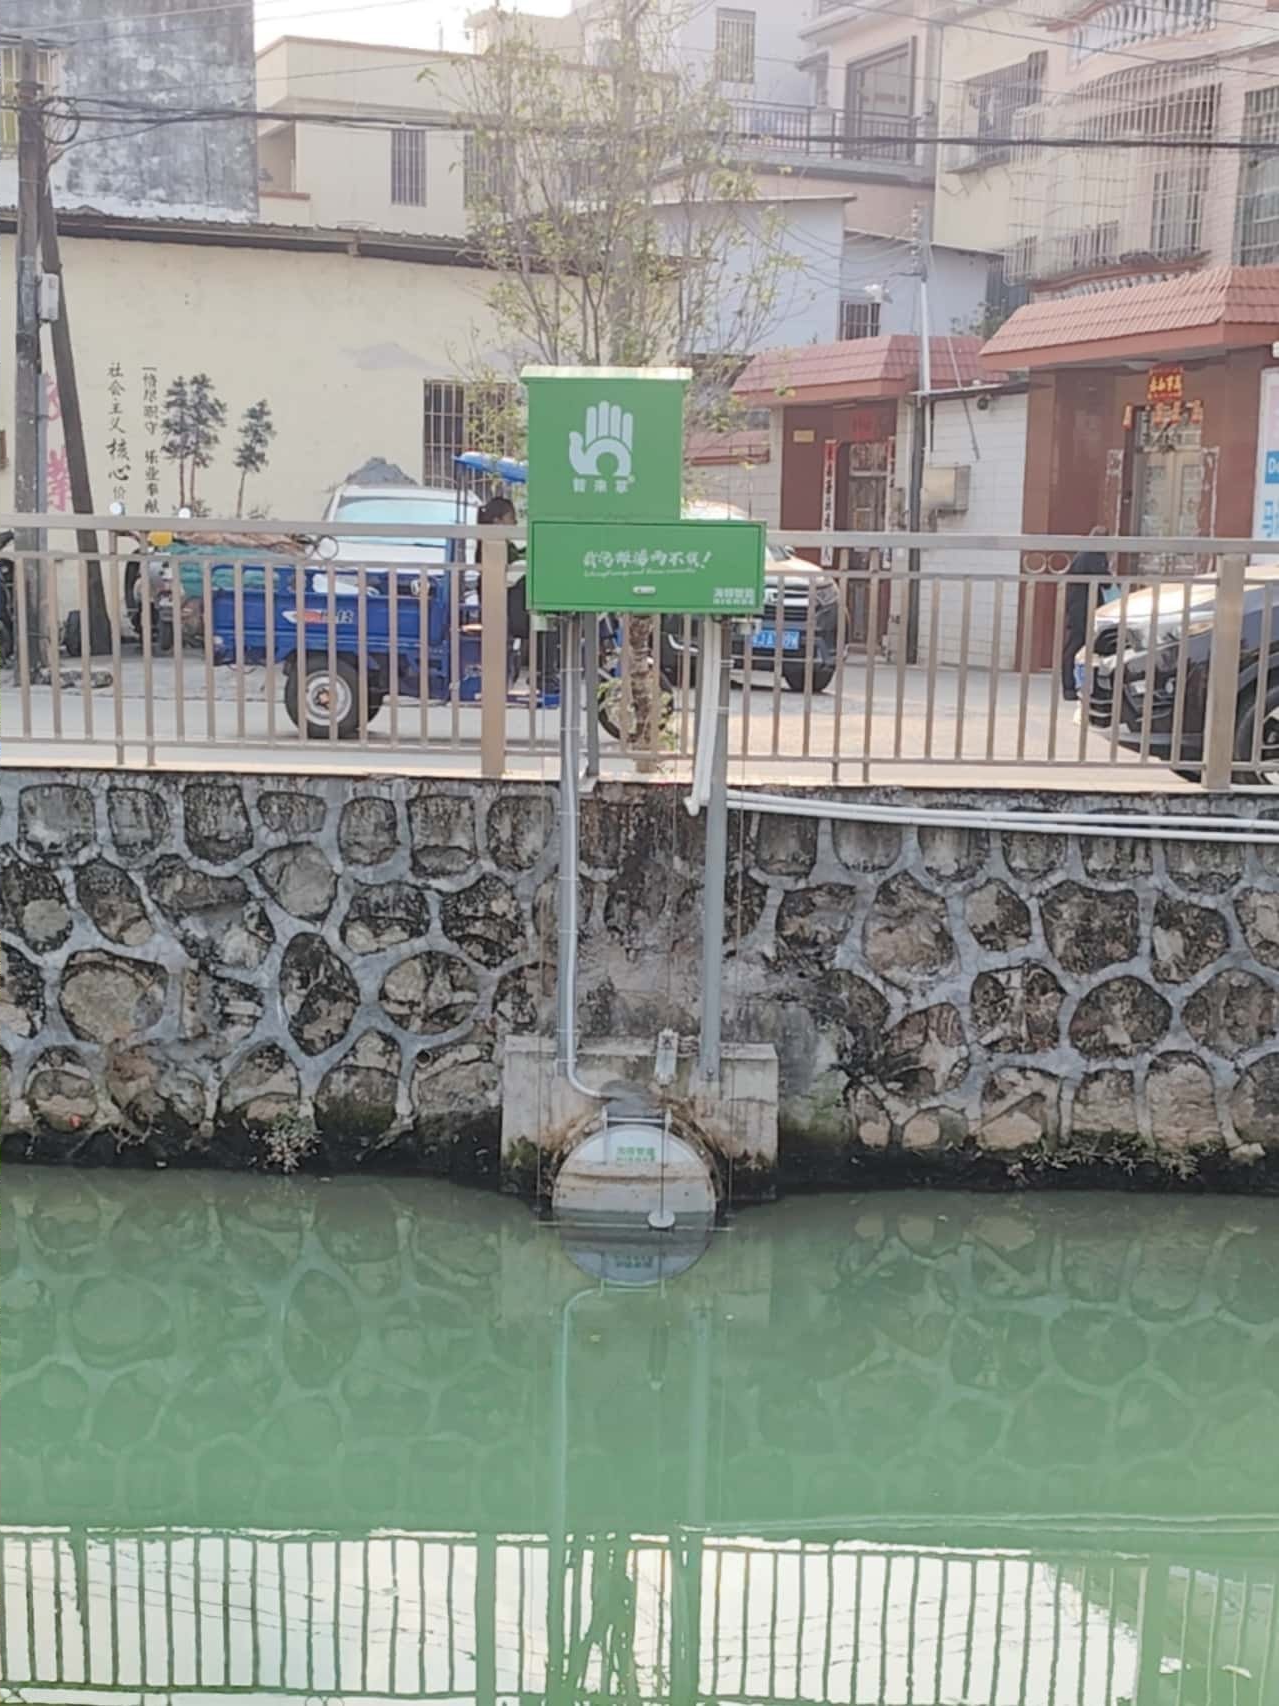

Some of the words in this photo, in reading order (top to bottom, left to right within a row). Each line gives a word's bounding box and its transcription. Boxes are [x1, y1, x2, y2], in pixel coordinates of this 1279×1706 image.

[105, 362, 131, 515] 社会主义核心价
